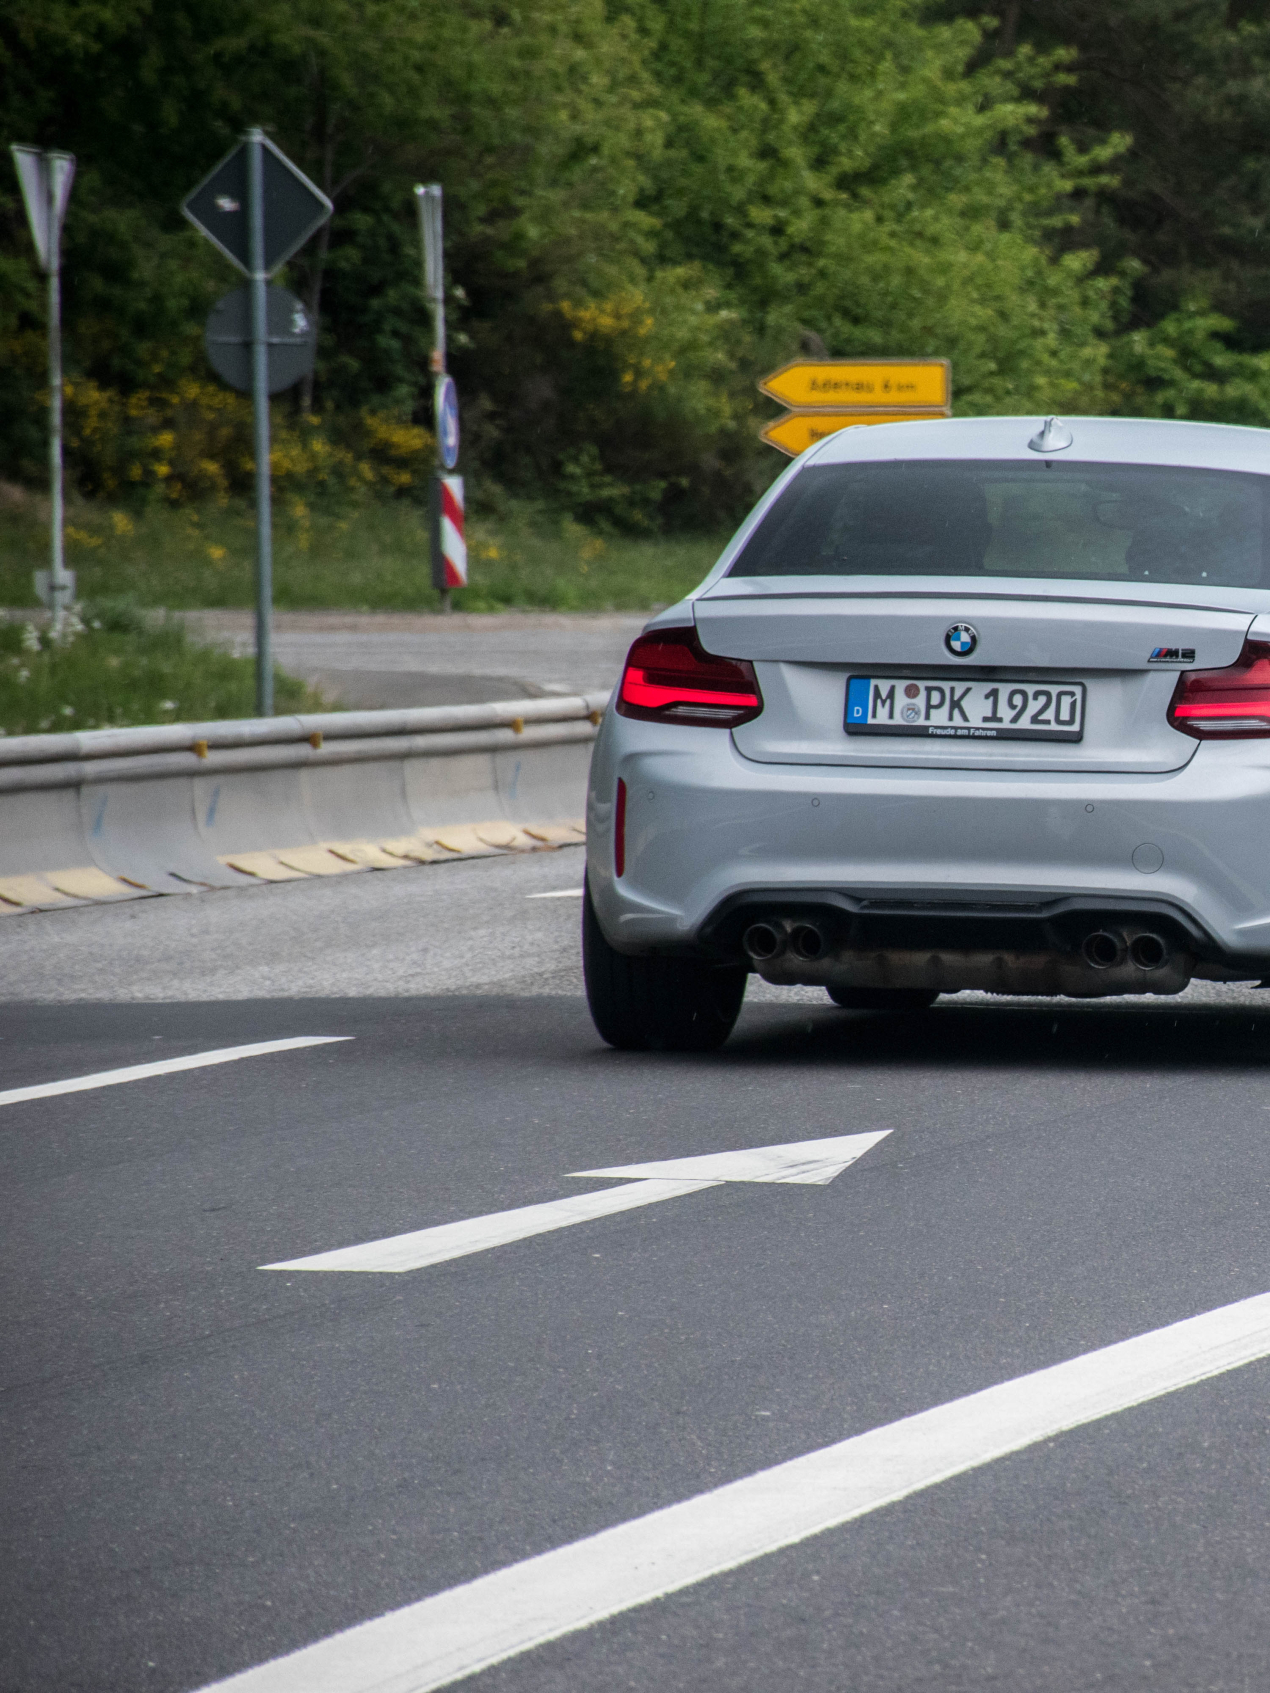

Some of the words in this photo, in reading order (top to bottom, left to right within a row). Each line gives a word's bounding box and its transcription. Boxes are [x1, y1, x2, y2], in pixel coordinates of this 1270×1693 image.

[947, 625, 975, 637] BMW
[853, 706, 863, 717] D
[871, 684, 896, 720] M
[924, 685, 973, 722] PK
[982, 687, 1077, 727] 1920
[928, 727, 955, 735] Freude
[970, 728, 997, 737] Fahren
